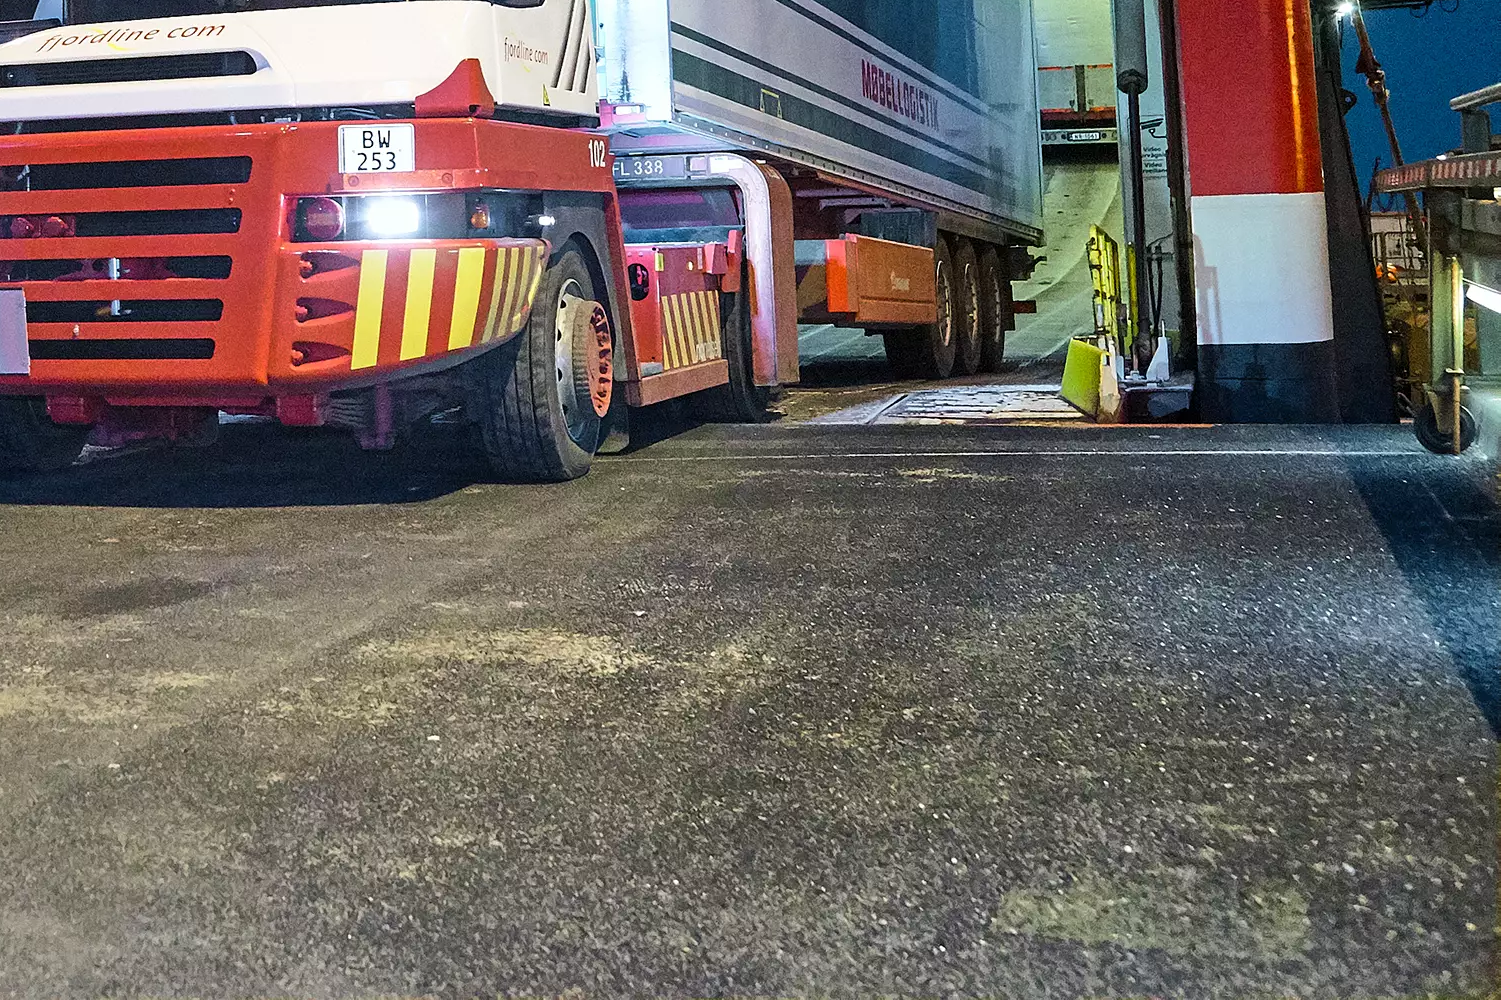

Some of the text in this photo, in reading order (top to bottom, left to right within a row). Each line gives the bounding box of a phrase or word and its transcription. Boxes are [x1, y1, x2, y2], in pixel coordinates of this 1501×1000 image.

[362, 130, 391, 149] BW
[357, 151, 396, 171] 253
[588, 139, 606, 168] 102
[612, 161, 630, 176] FL
